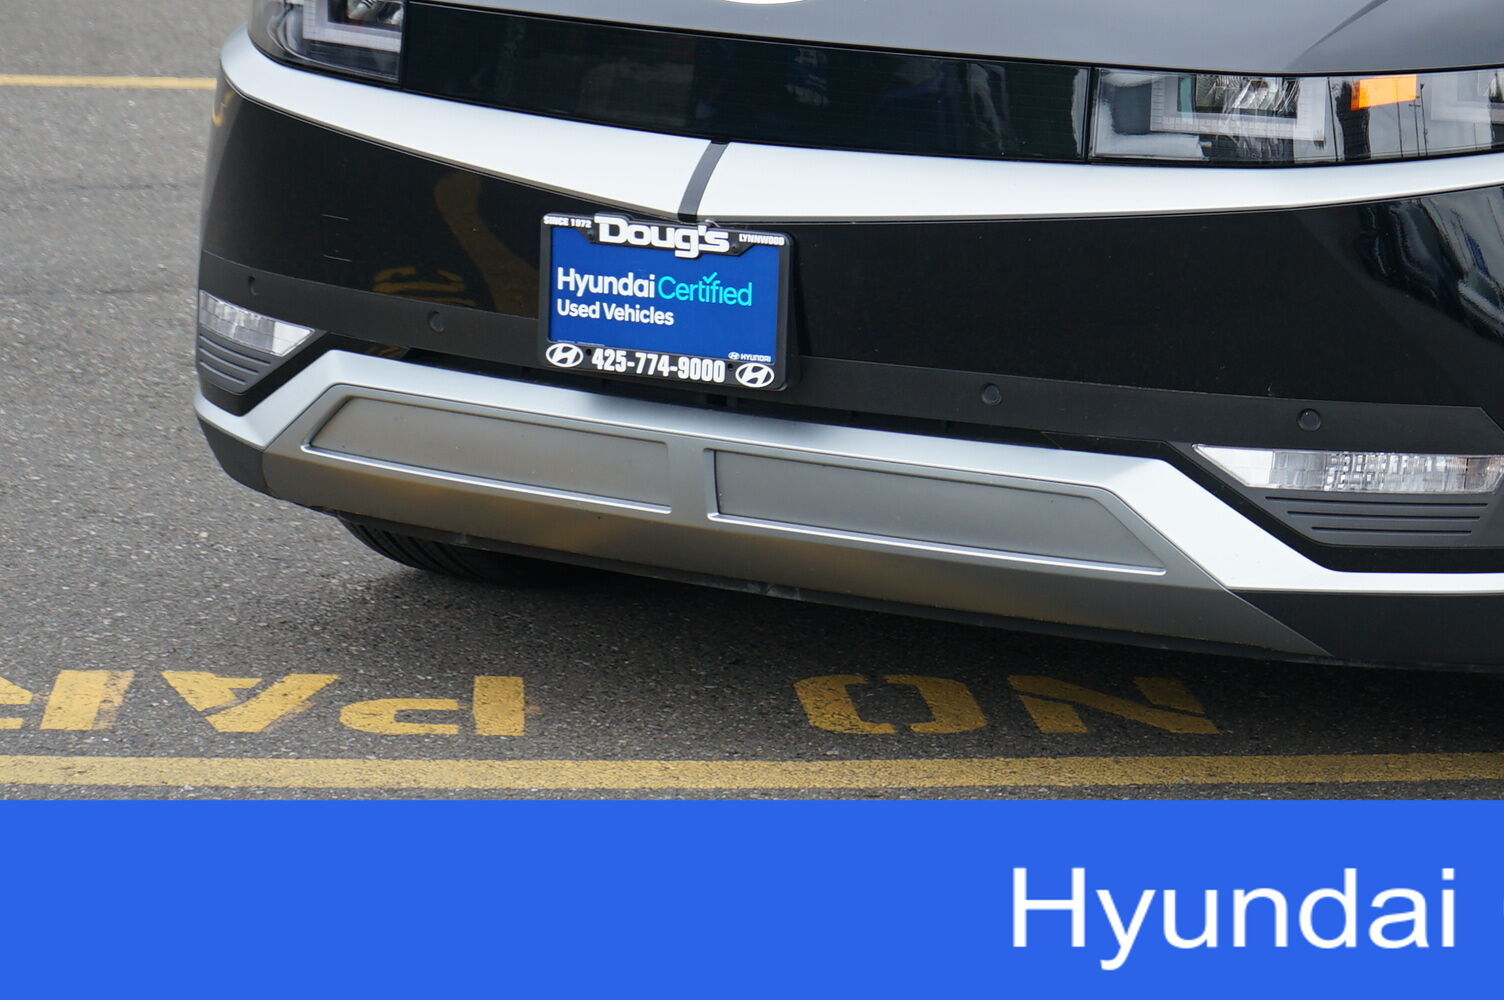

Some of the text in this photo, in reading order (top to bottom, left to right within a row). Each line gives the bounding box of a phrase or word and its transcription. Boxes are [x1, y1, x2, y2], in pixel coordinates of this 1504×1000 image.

[543, 216, 592, 229] SINCE 1972
[594, 216, 730, 258] Doug's
[738, 233, 785, 246] LYNNWOOD
[557, 267, 753, 307] Hyundai Certified
[557, 298, 675, 326] Used Vehicles
[591, 348, 726, 384] 425-774-9000
[740, 352, 772, 363] HYUNDAI
[793, 673, 1222, 735] NO
